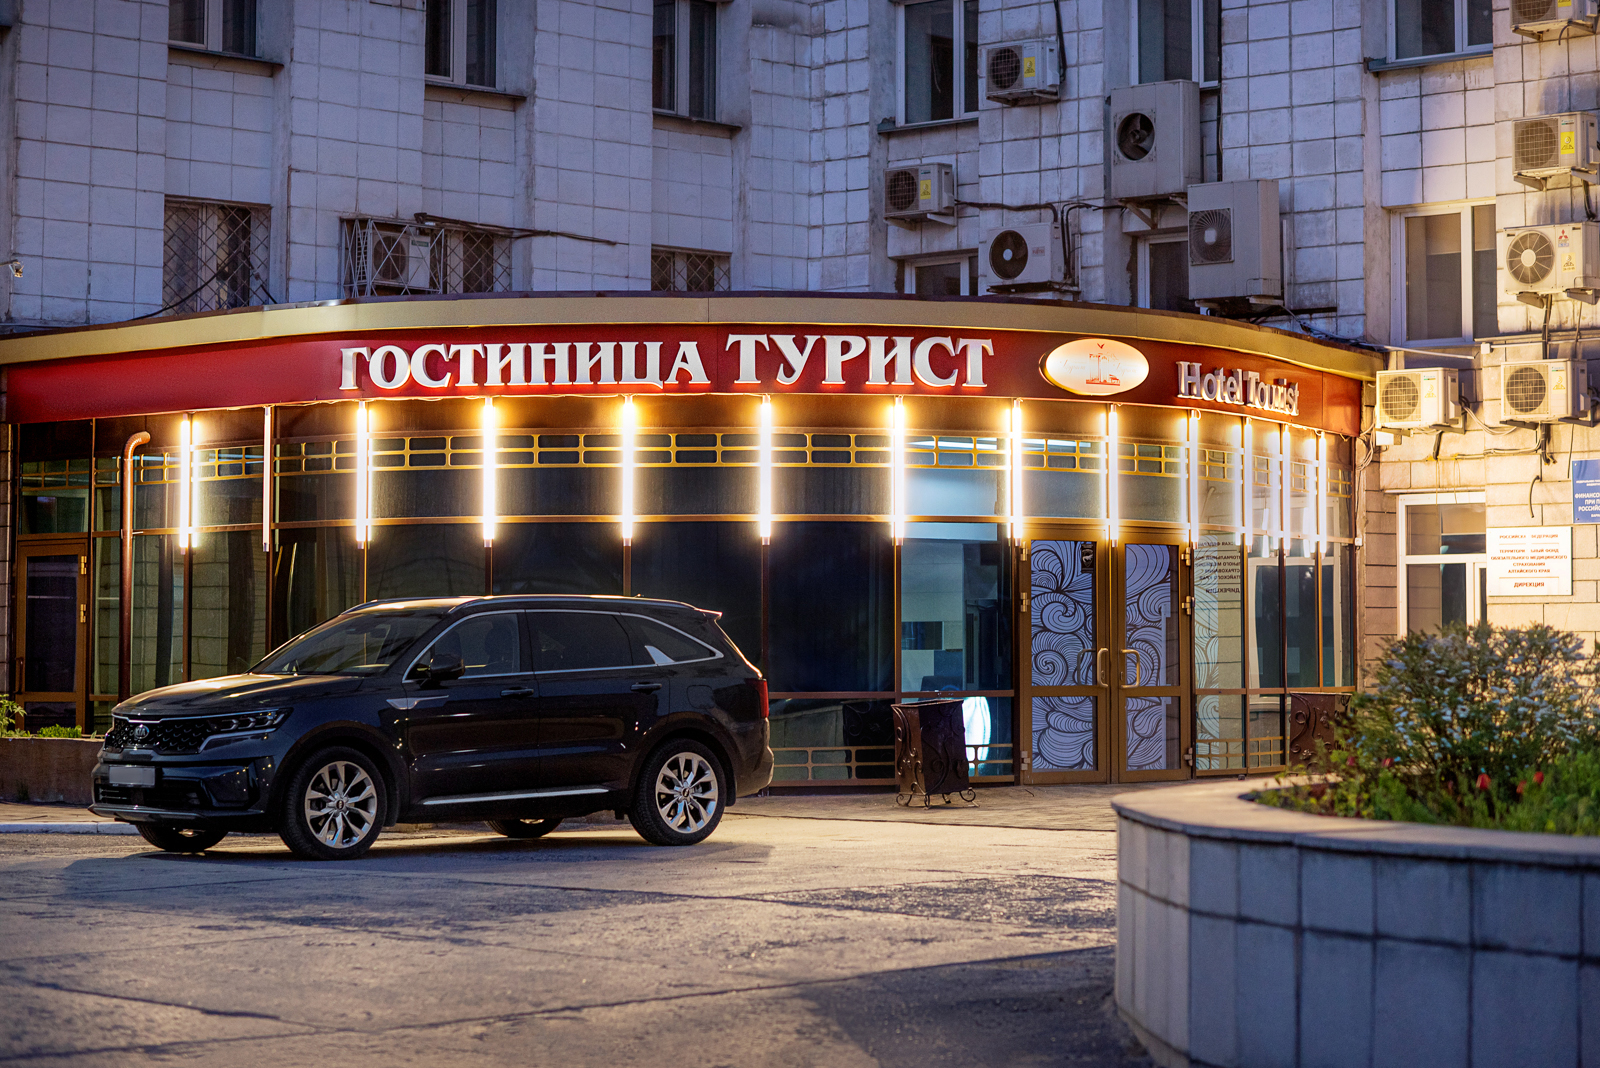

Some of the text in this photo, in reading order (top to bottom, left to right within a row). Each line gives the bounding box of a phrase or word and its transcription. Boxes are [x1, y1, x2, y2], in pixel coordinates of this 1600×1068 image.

[339, 333, 995, 391] ГОСТИНИЦА ТУРИСТ
[1175, 361, 1300, 416] Hotel Tourist
